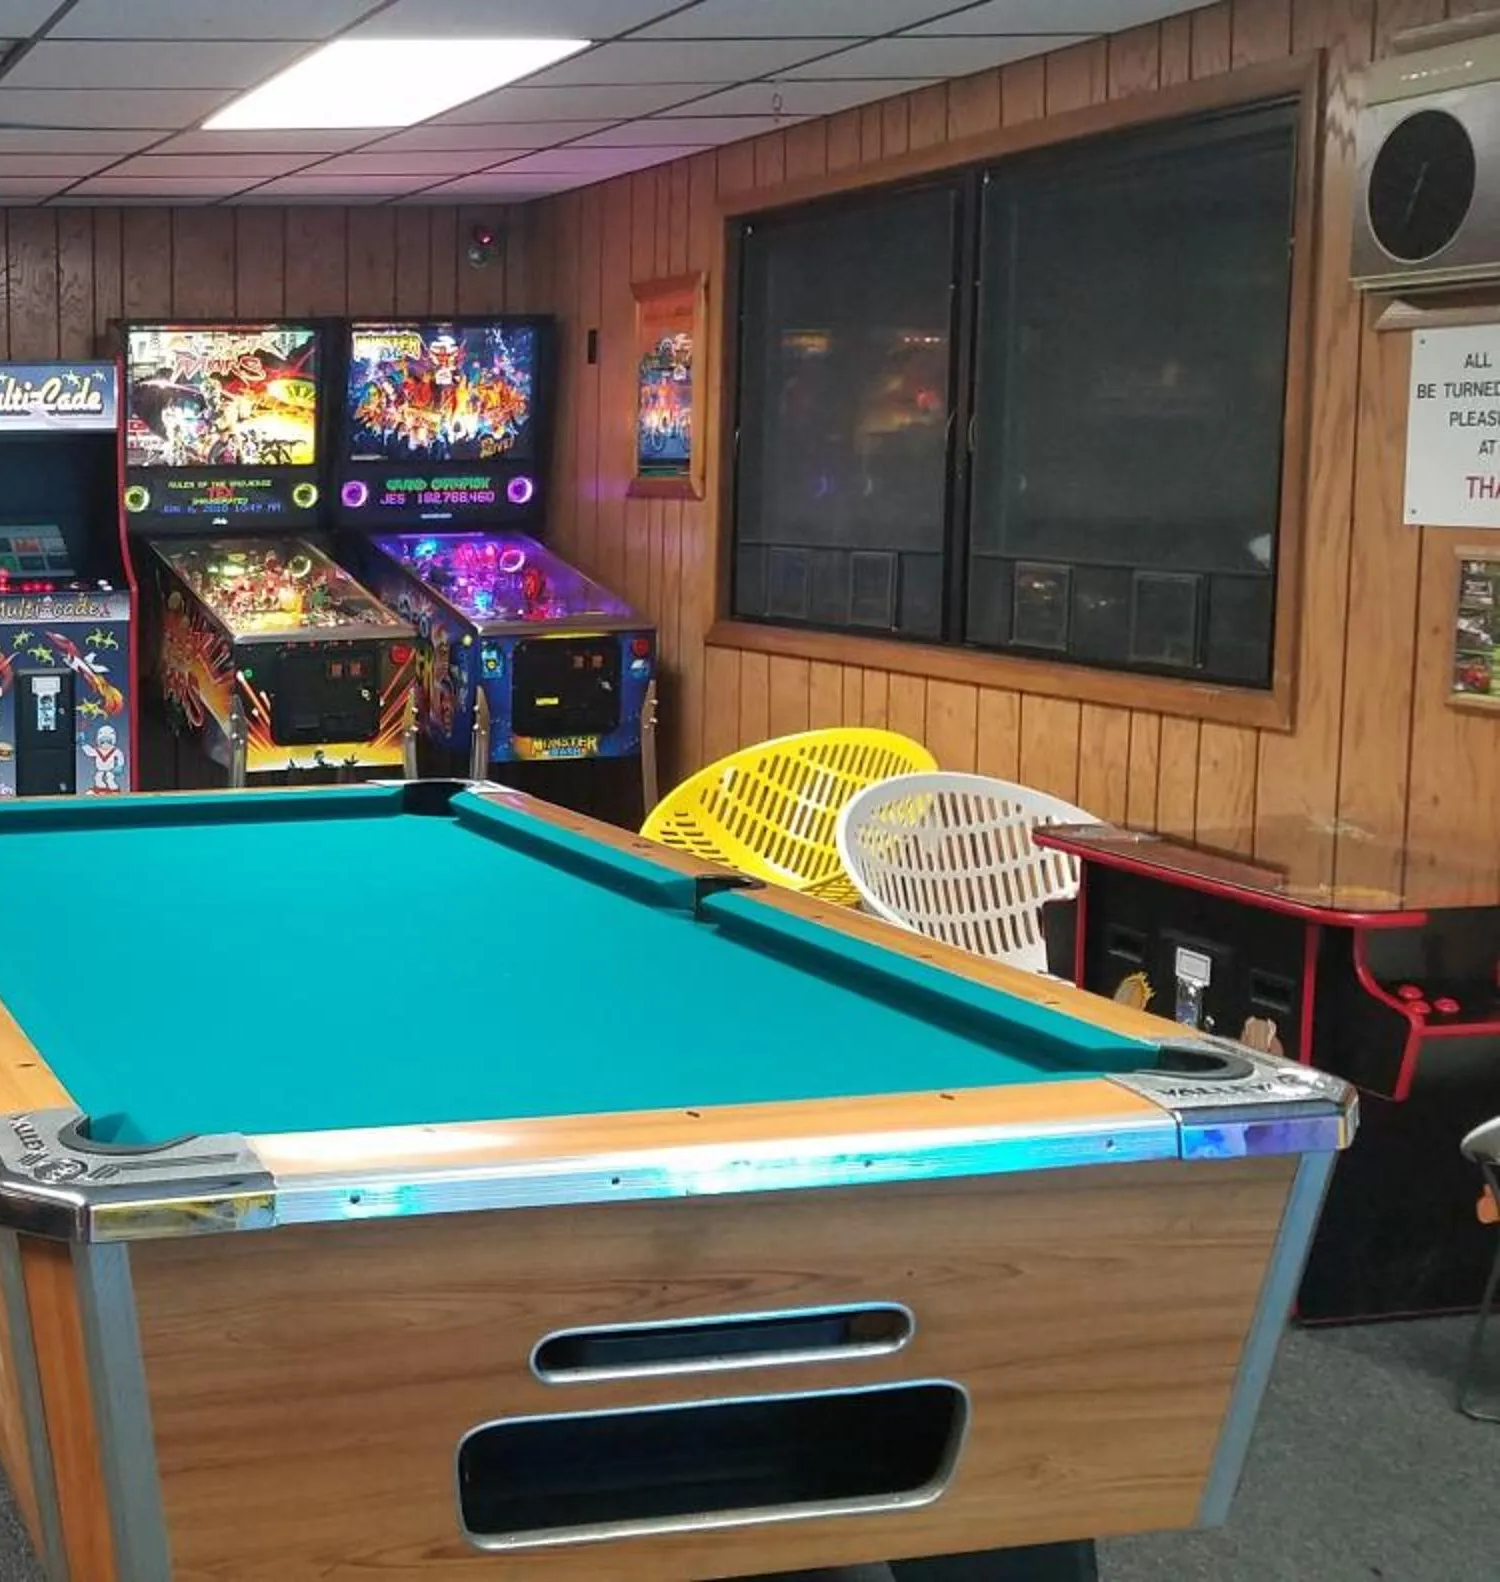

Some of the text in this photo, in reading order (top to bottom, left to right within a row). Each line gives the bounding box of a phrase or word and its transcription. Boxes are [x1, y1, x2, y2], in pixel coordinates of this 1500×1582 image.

[1464, 352, 1492, 369] ALL
[1417, 383, 1436, 399] BE
[1449, 409, 1500, 427] PLEAS
[1478, 439, 1498, 454] AT
[1466, 475, 1500, 500] TH
